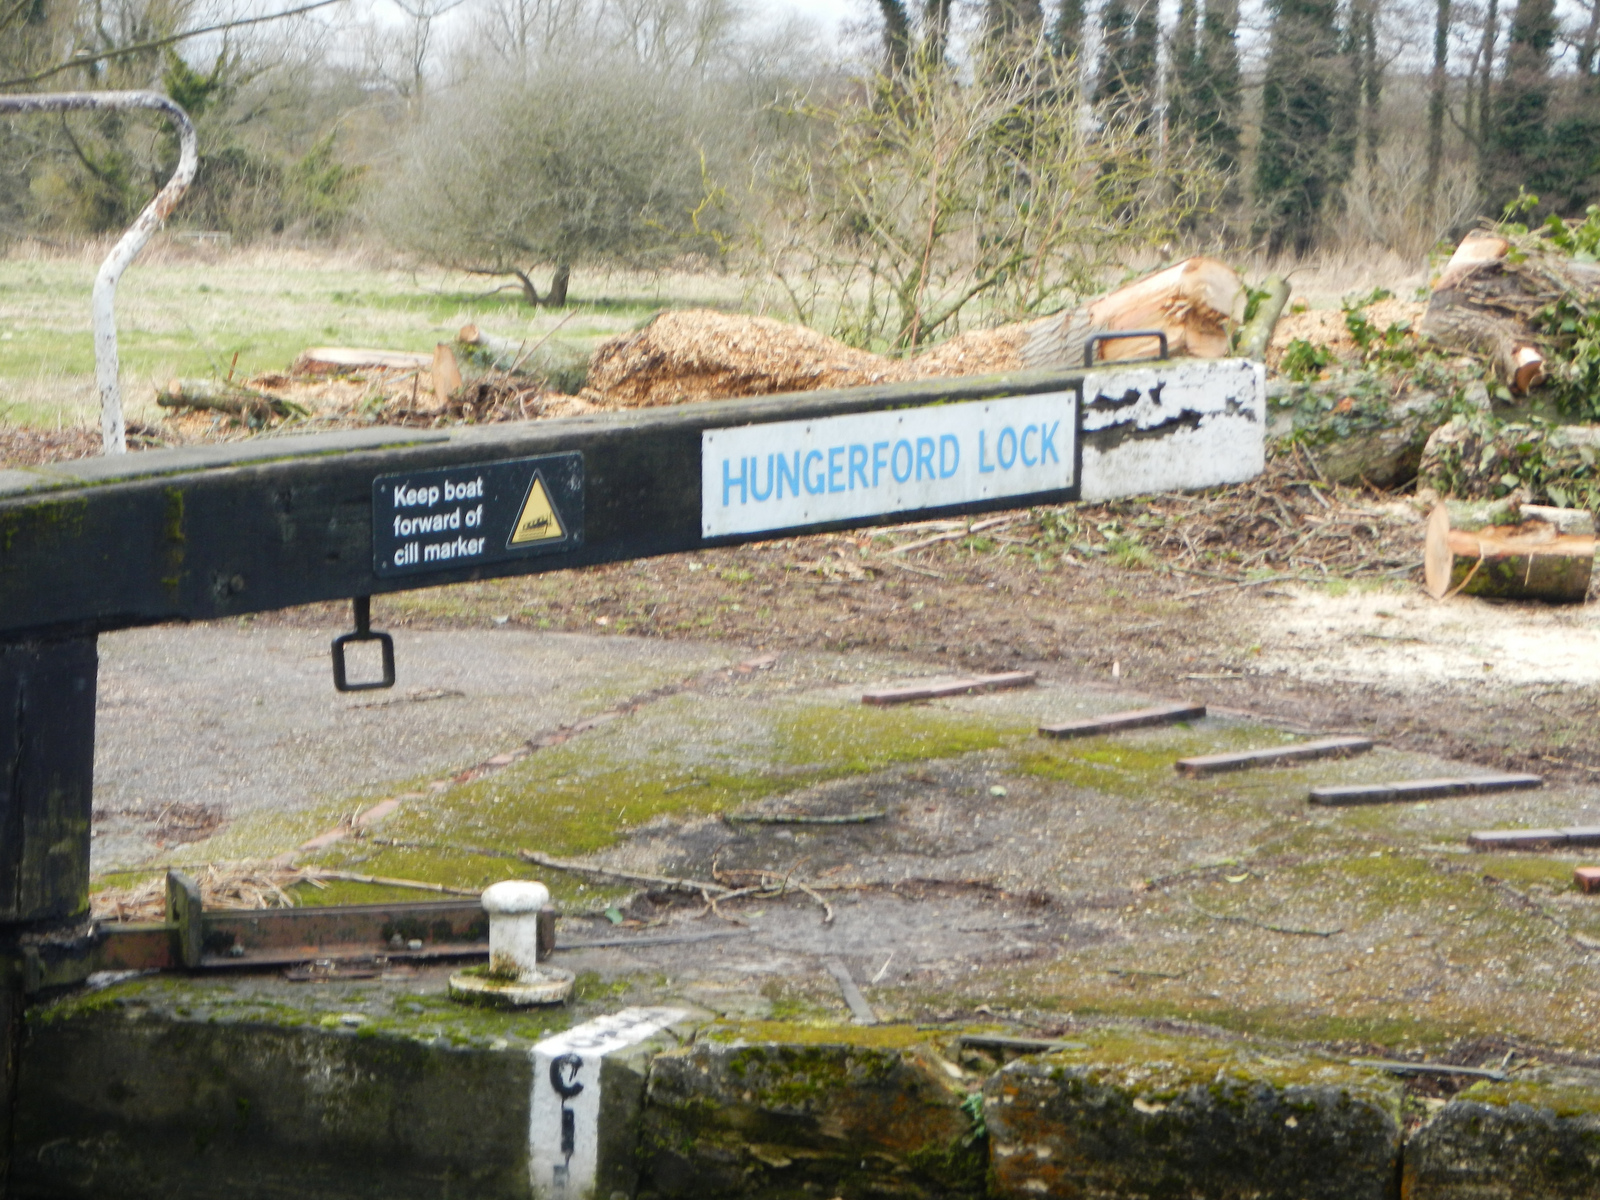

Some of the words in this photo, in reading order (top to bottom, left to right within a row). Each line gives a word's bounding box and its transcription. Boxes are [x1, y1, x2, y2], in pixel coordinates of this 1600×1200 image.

[722, 433, 960, 507] HUNGERFORD
[978, 420, 1060, 473] LOCK
[394, 484, 439, 507] Keep
[444, 476, 483, 501] boat
[393, 507, 460, 537] forward
[465, 504, 483, 528] of
[394, 542, 418, 566] cill
[424, 537, 485, 562] marker
